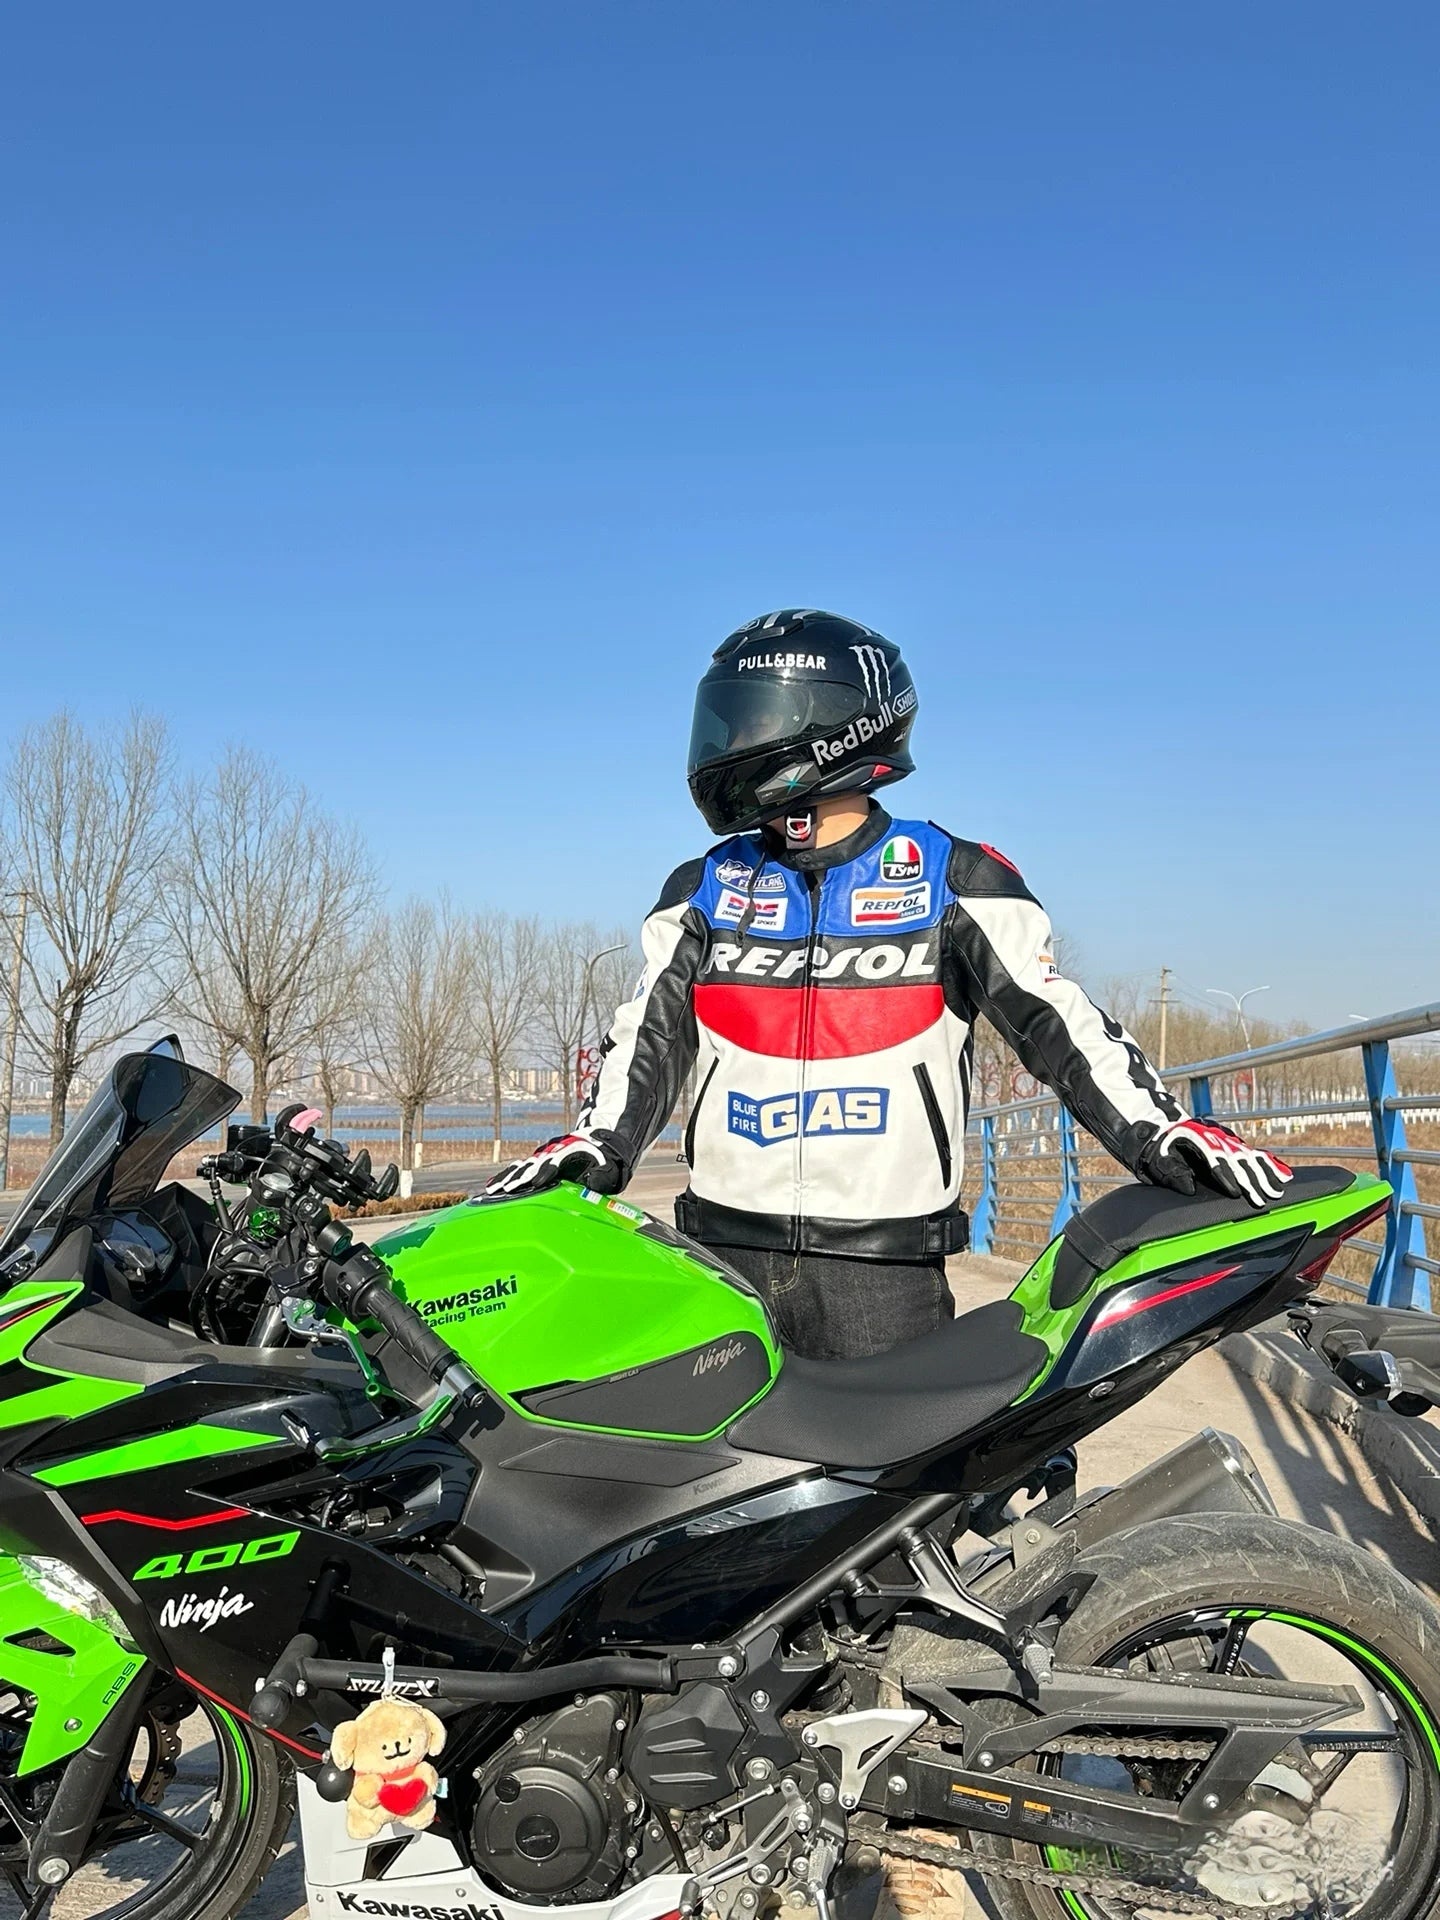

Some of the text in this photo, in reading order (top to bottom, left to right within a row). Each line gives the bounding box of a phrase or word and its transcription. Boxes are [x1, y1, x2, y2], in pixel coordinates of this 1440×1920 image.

[738, 653, 827, 672] PULL&BEAR
[738, 876, 783, 888] FTLANE
[862, 896, 920, 911] REPSOL
[705, 942, 936, 979] REPSOL
[733, 1100, 758, 1117] BLUE
[760, 1092, 881, 1140] GAS
[733, 1117, 758, 1134] FIRE
[407, 1275, 518, 1318] Kawasaki
[468, 1302, 506, 1317] Team
[693, 1338, 748, 1377] Ninja
[133, 1531, 301, 1581] 400
[160, 1585, 255, 1633] Ninja
[102, 1661, 136, 1705] ABS
[336, 1890, 505, 1920] Kawasaki
